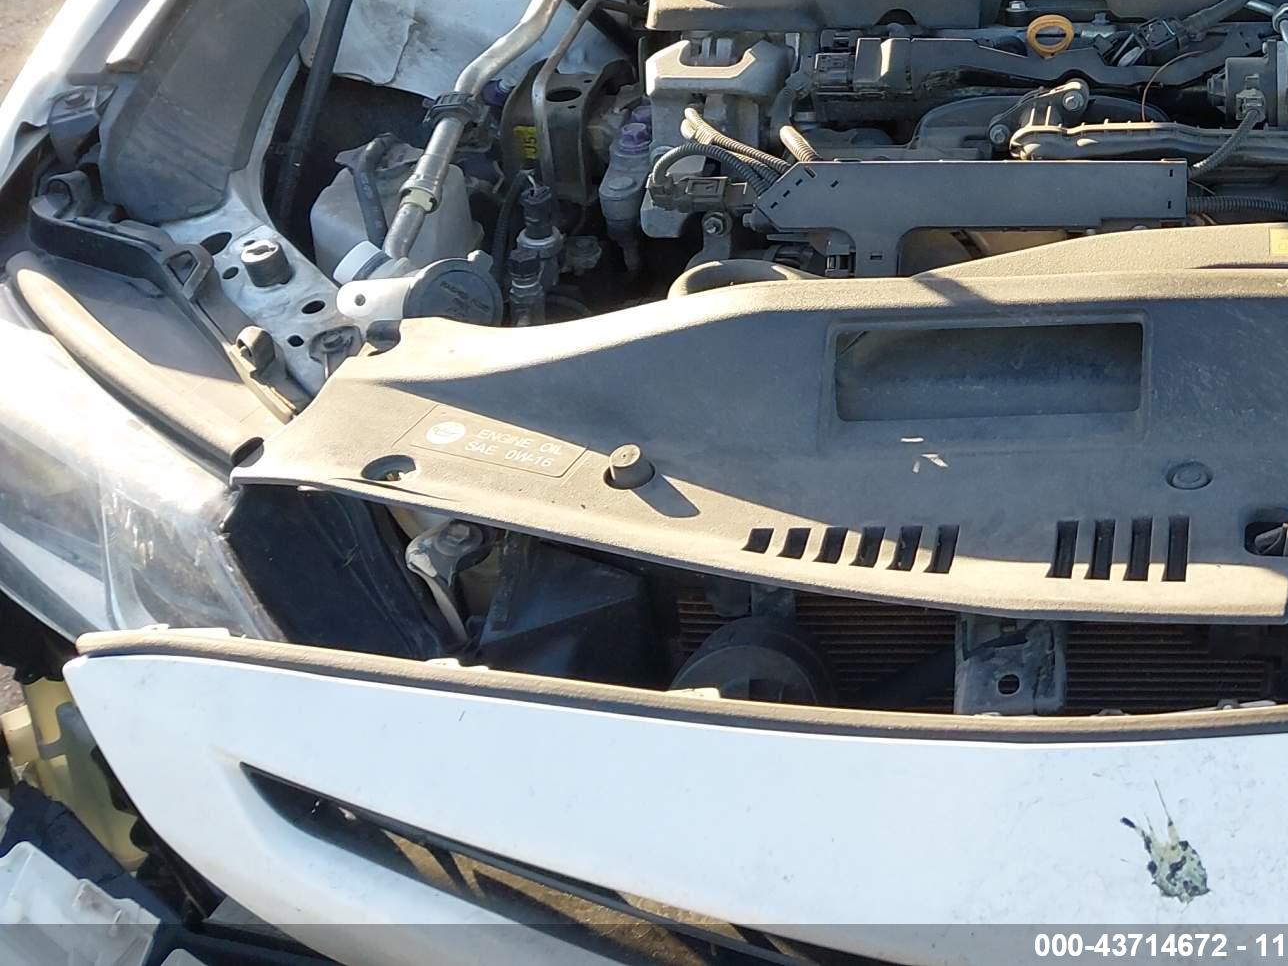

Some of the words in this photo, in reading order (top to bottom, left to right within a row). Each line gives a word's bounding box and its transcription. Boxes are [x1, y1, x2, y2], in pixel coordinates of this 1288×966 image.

[465, 441, 498, 455] SAE
[505, 449, 553, 467] 0W-16
[477, 429, 533, 448] ENGINE
[540, 442, 562, 455] OIL
